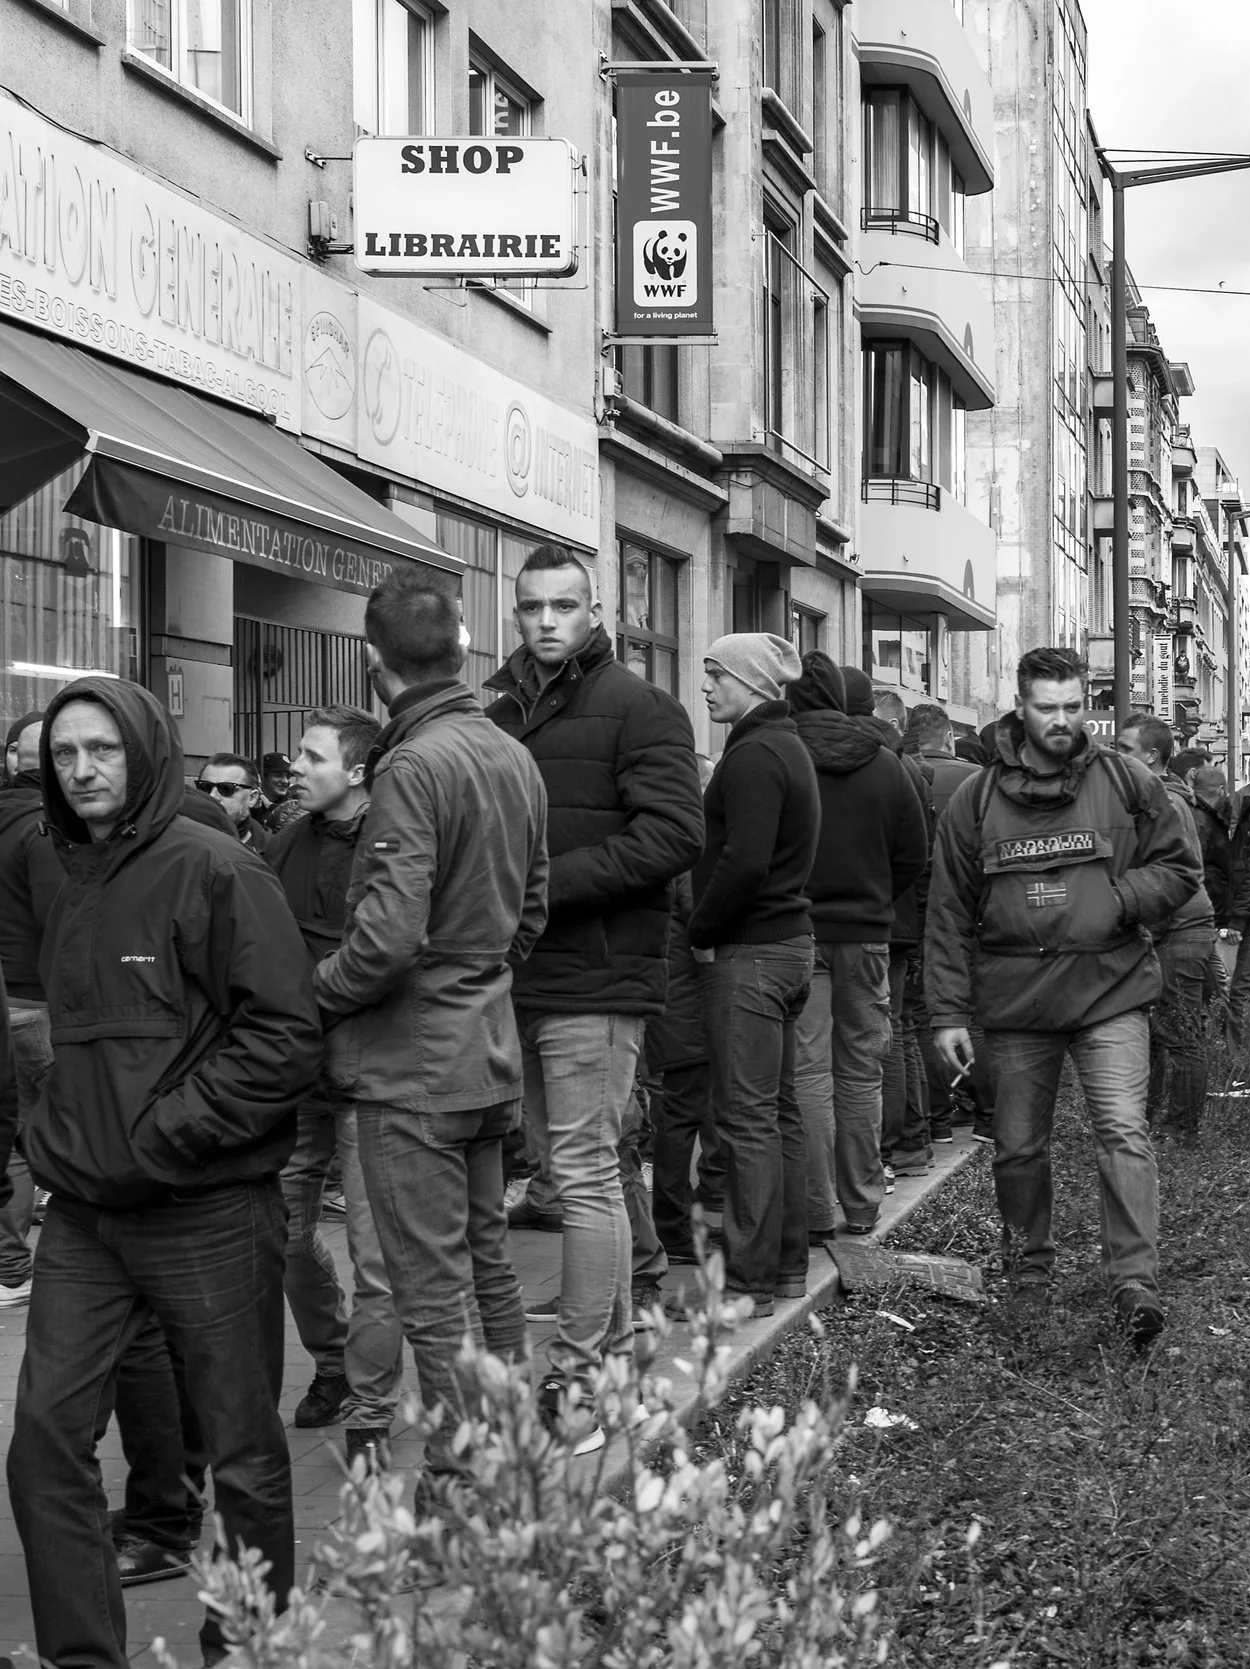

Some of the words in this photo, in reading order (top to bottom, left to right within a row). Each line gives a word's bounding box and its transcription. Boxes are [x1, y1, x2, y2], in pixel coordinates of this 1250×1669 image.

[401, 145, 524, 174] SHOP
[647, 90, 680, 212] WWF.be
[365, 233, 561, 258] LIBRAIRIE
[644, 284, 687, 298] WWF
[652, 312, 673, 320] living
[674, 312, 698, 320] planet
[157, 495, 327, 577] ALIMENTATION
[1157, 661, 1168, 671] du
[1000, 833, 1093, 861] NAPAPIJRI
[121, 955, 156, 963] carhartt
